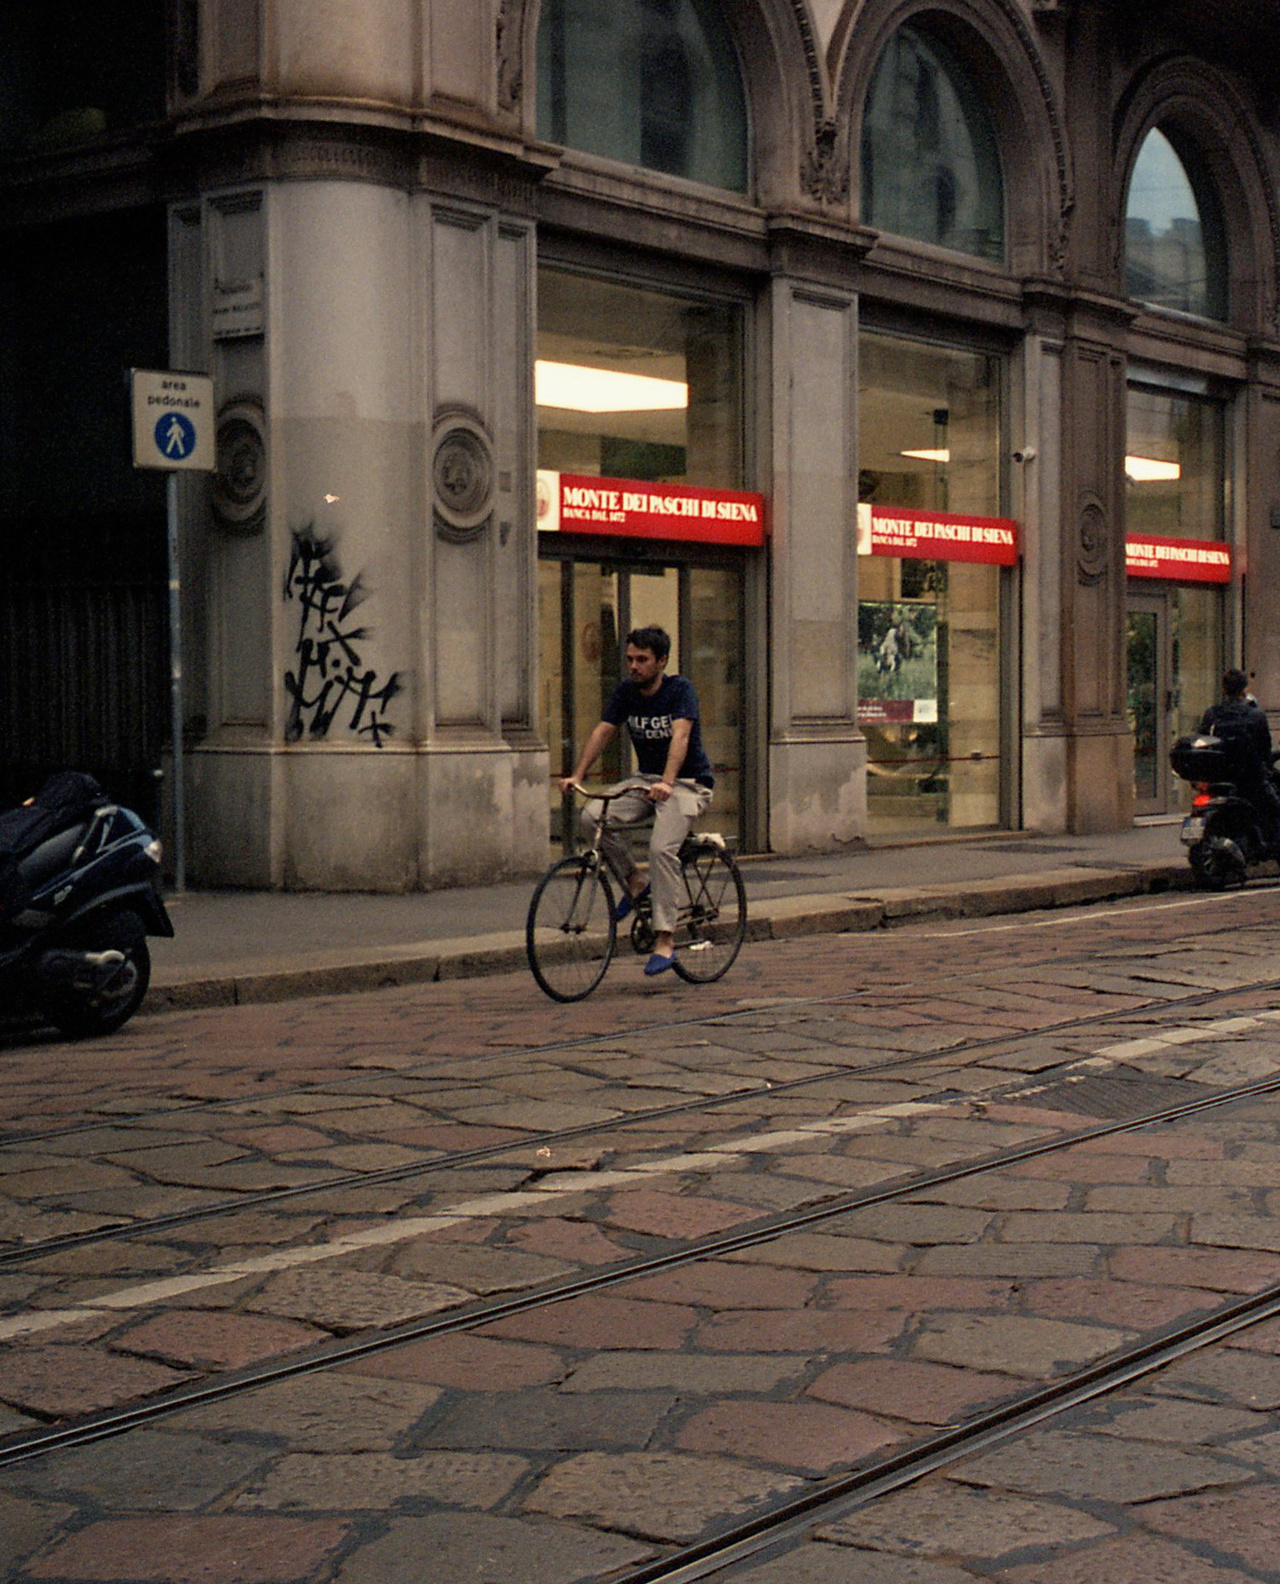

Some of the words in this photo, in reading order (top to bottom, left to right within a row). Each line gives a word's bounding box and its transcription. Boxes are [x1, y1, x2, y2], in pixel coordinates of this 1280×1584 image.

[162, 381, 186, 390] area
[148, 396, 200, 407] pedonale
[563, 486, 619, 510] MONTE
[622, 492, 647, 513] DEI
[650, 495, 699, 518] PASCHI
[701, 500, 717, 518] DI
[717, 501, 758, 522] SIENA
[563, 507, 590, 519] BANCA
[592, 510, 608, 521] DAL
[872, 517, 913, 537] MONTE
[914, 521, 933, 538] DEI
[934, 523, 971, 542] PASCHI
[983, 528, 1014, 545] SIENA
